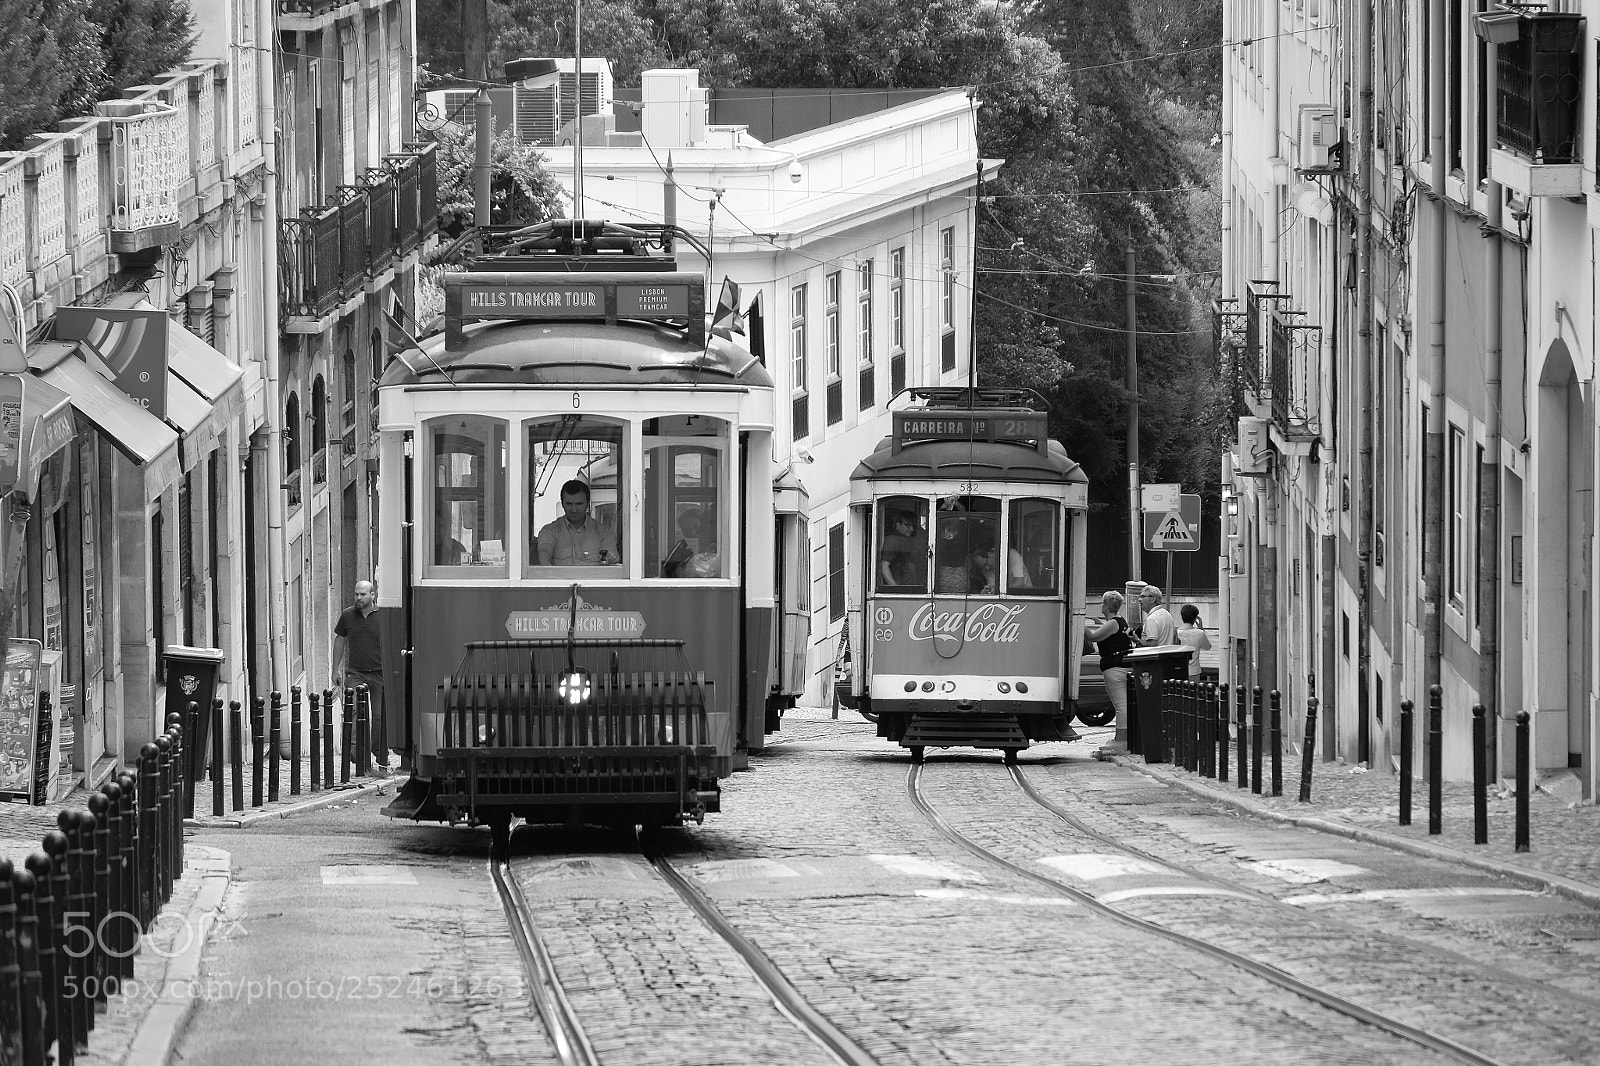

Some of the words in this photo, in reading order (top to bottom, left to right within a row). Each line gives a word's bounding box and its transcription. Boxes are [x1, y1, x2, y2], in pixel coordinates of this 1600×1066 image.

[470, 292, 507, 307] HILLS
[510, 292, 561, 307] TRAMCAR
[565, 292, 596, 307] TOUR
[572, 392, 580, 408] 6
[903, 421, 964, 434] CARREIRA
[1004, 419, 1028, 437] 28
[959, 483, 979, 492] 582
[515, 617, 550, 632] HILLS
[607, 617, 638, 632] TOUR
